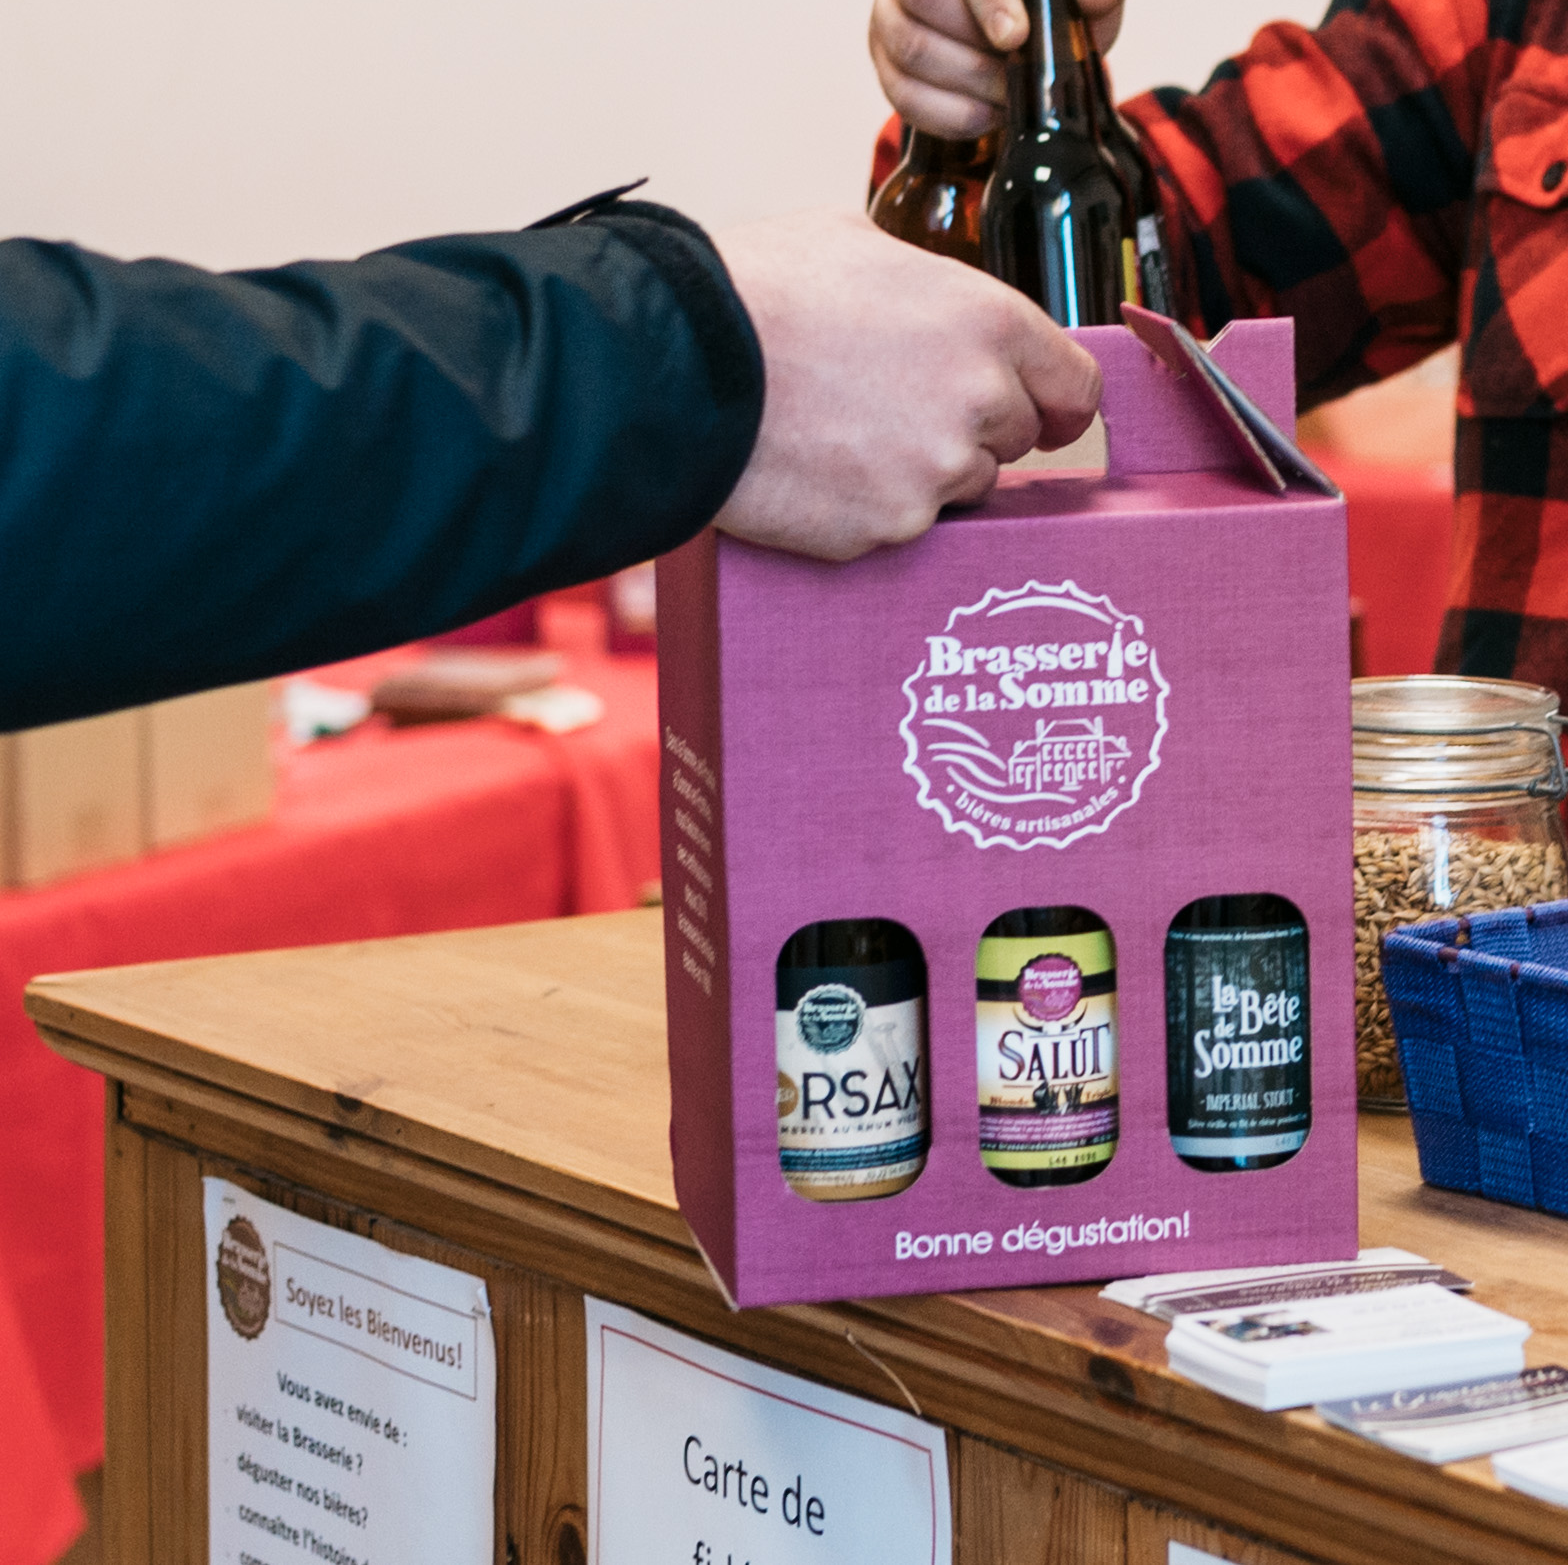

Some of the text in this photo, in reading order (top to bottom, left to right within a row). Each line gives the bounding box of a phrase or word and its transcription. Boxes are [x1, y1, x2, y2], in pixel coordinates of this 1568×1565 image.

[925, 621, 1149, 677] Brasserie
[923, 664, 1149, 713] de la Somme
[1014, 785, 1119, 833] artisanales
[1212, 975, 1240, 1013] La
[1239, 989, 1301, 1036] Bête
[998, 1022, 1111, 1081] SALUT
[1214, 1017, 1236, 1038] de
[1194, 1030, 1303, 1078] Somme
[1205, 1088, 1295, 1112] IMPERIAL STOUT
[895, 1210, 1190, 1260] Bonne dégustation!
[286, 1277, 463, 1370] Soyez les Bienvenus!
[276, 1369, 311, 1404] Vous
[315, 1389, 345, 1419] avez
[347, 1403, 381, 1435] envie
[383, 1418, 401, 1444] de
[236, 1403, 274, 1436] visiter
[276, 1419, 290, 1443] la
[292, 1427, 354, 1472] Brasserie
[237, 1452, 368, 1529] déguster nos bières?
[683, 1435, 825, 1536] Carte de
[239, 1504, 300, 1546] connaître
